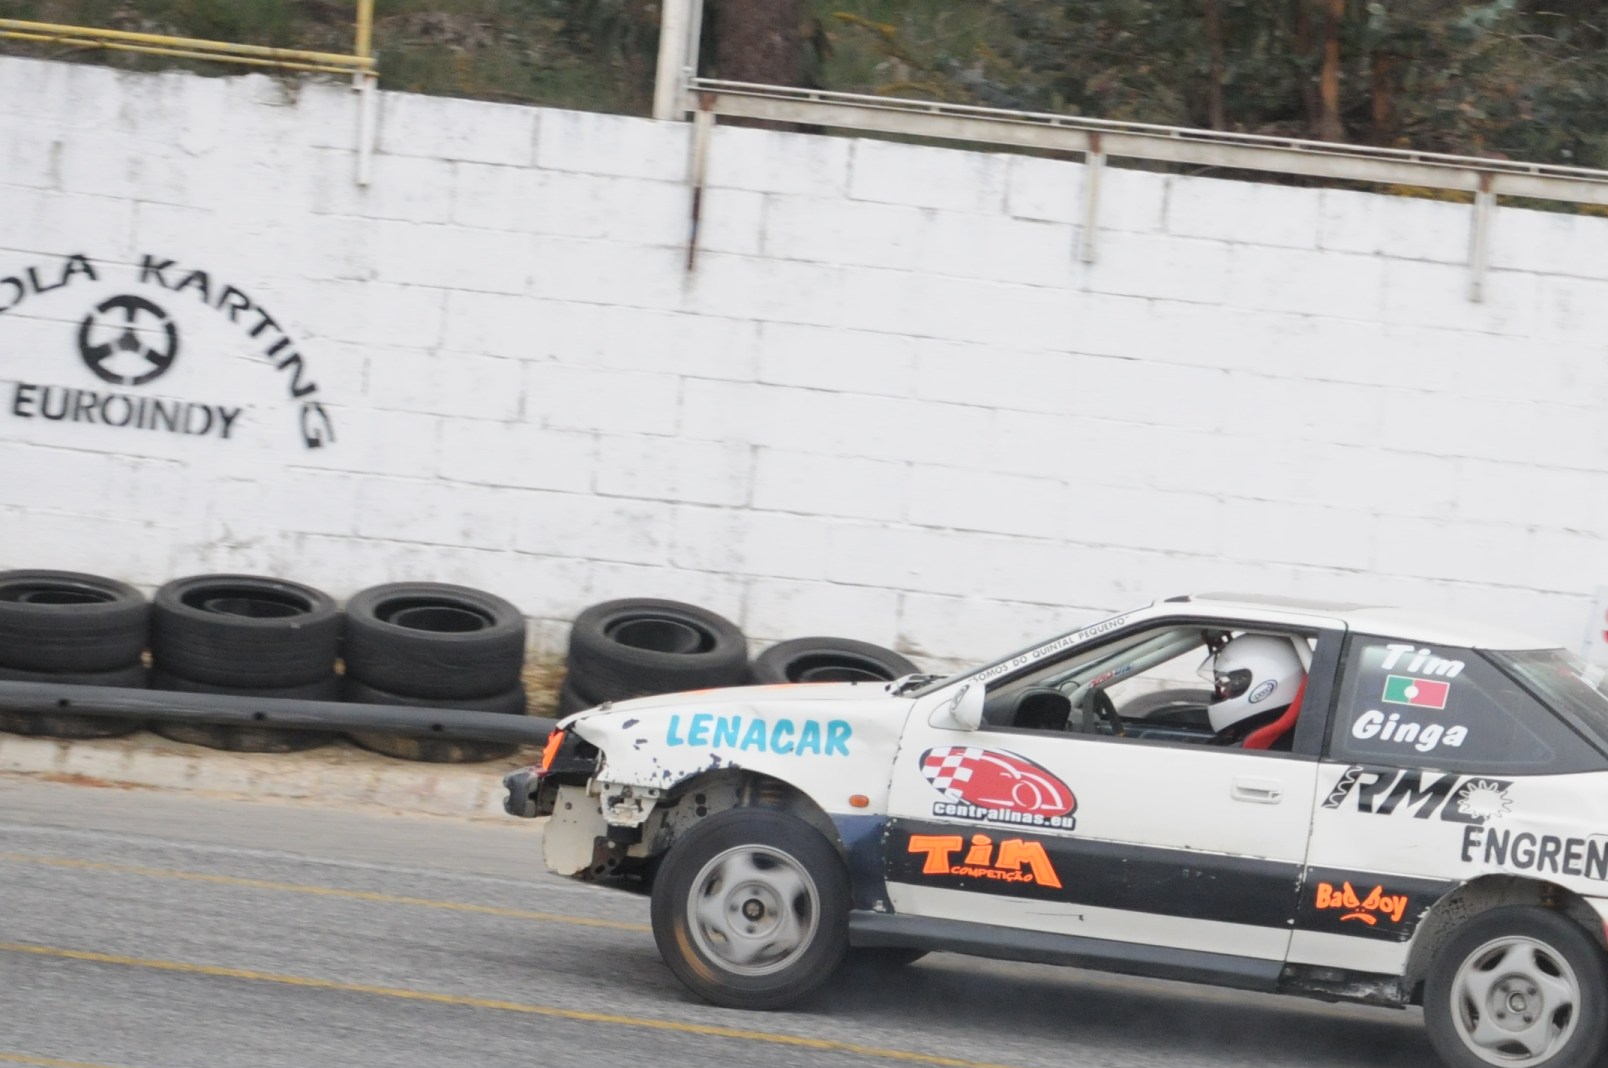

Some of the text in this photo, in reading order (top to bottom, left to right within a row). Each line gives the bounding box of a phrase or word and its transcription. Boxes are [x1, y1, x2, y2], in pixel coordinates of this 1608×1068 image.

[139, 254, 335, 449] KARTING
[11, 382, 241, 439] EUROINDY
[1013, 655, 1028, 667] DO
[1032, 637, 1075, 659] QUINTAL
[1381, 643, 1466, 678] Tim
[666, 713, 852, 757] LENACAR
[1351, 709, 1468, 752] Ginga
[933, 802, 1075, 829] centralinas.eu
[950, 865, 1033, 883] COMPETIÇÃO
